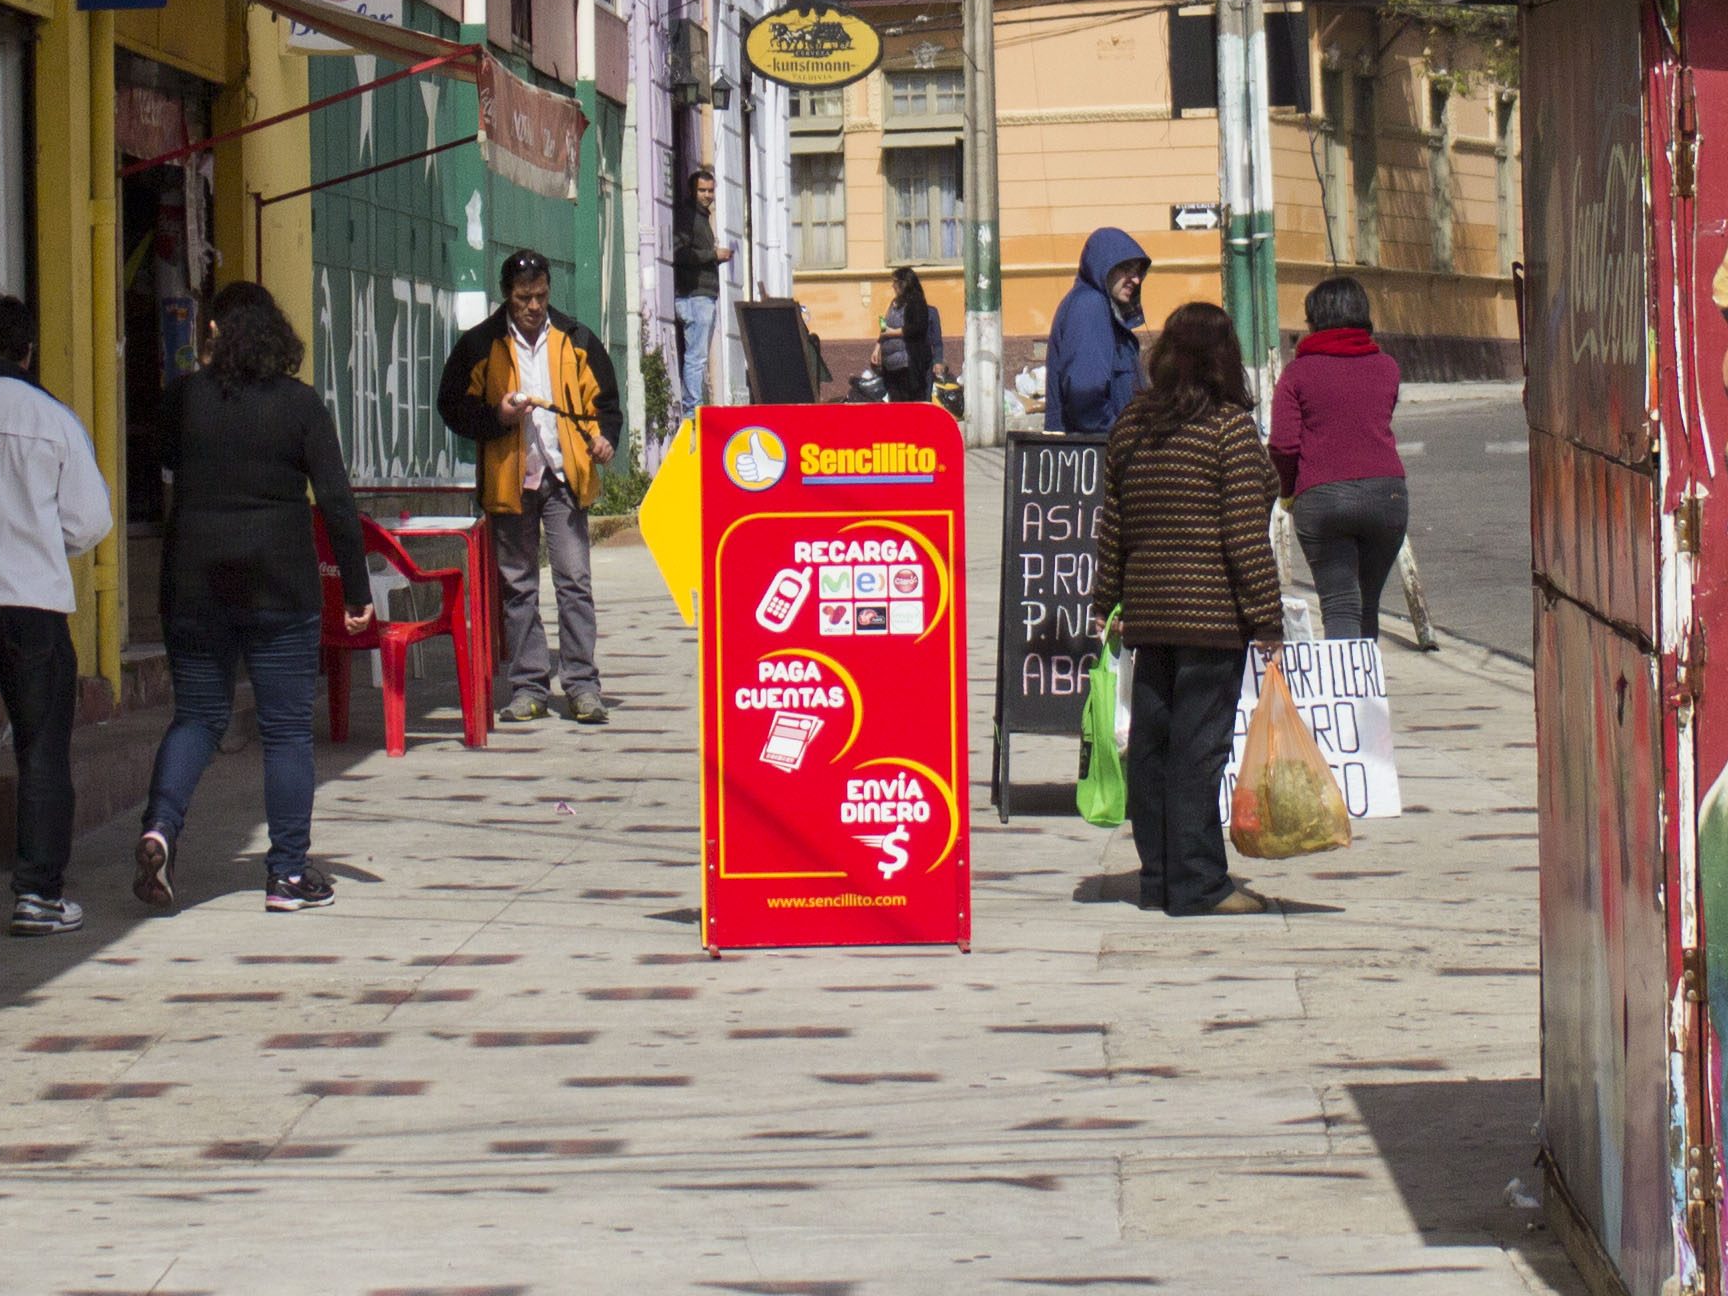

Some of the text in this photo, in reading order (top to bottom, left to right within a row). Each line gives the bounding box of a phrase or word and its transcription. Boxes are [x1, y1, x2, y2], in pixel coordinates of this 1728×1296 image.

[800, 441, 937, 475] Sencillito
[1020, 447, 1098, 496] LOMO
[793, 539, 918, 564] RECARGA
[758, 659, 822, 684] PAGA
[735, 686, 845, 710] CUENTAS
[840, 800, 931, 824] DINERO
[767, 892, 908, 909] www.sencillito.com
